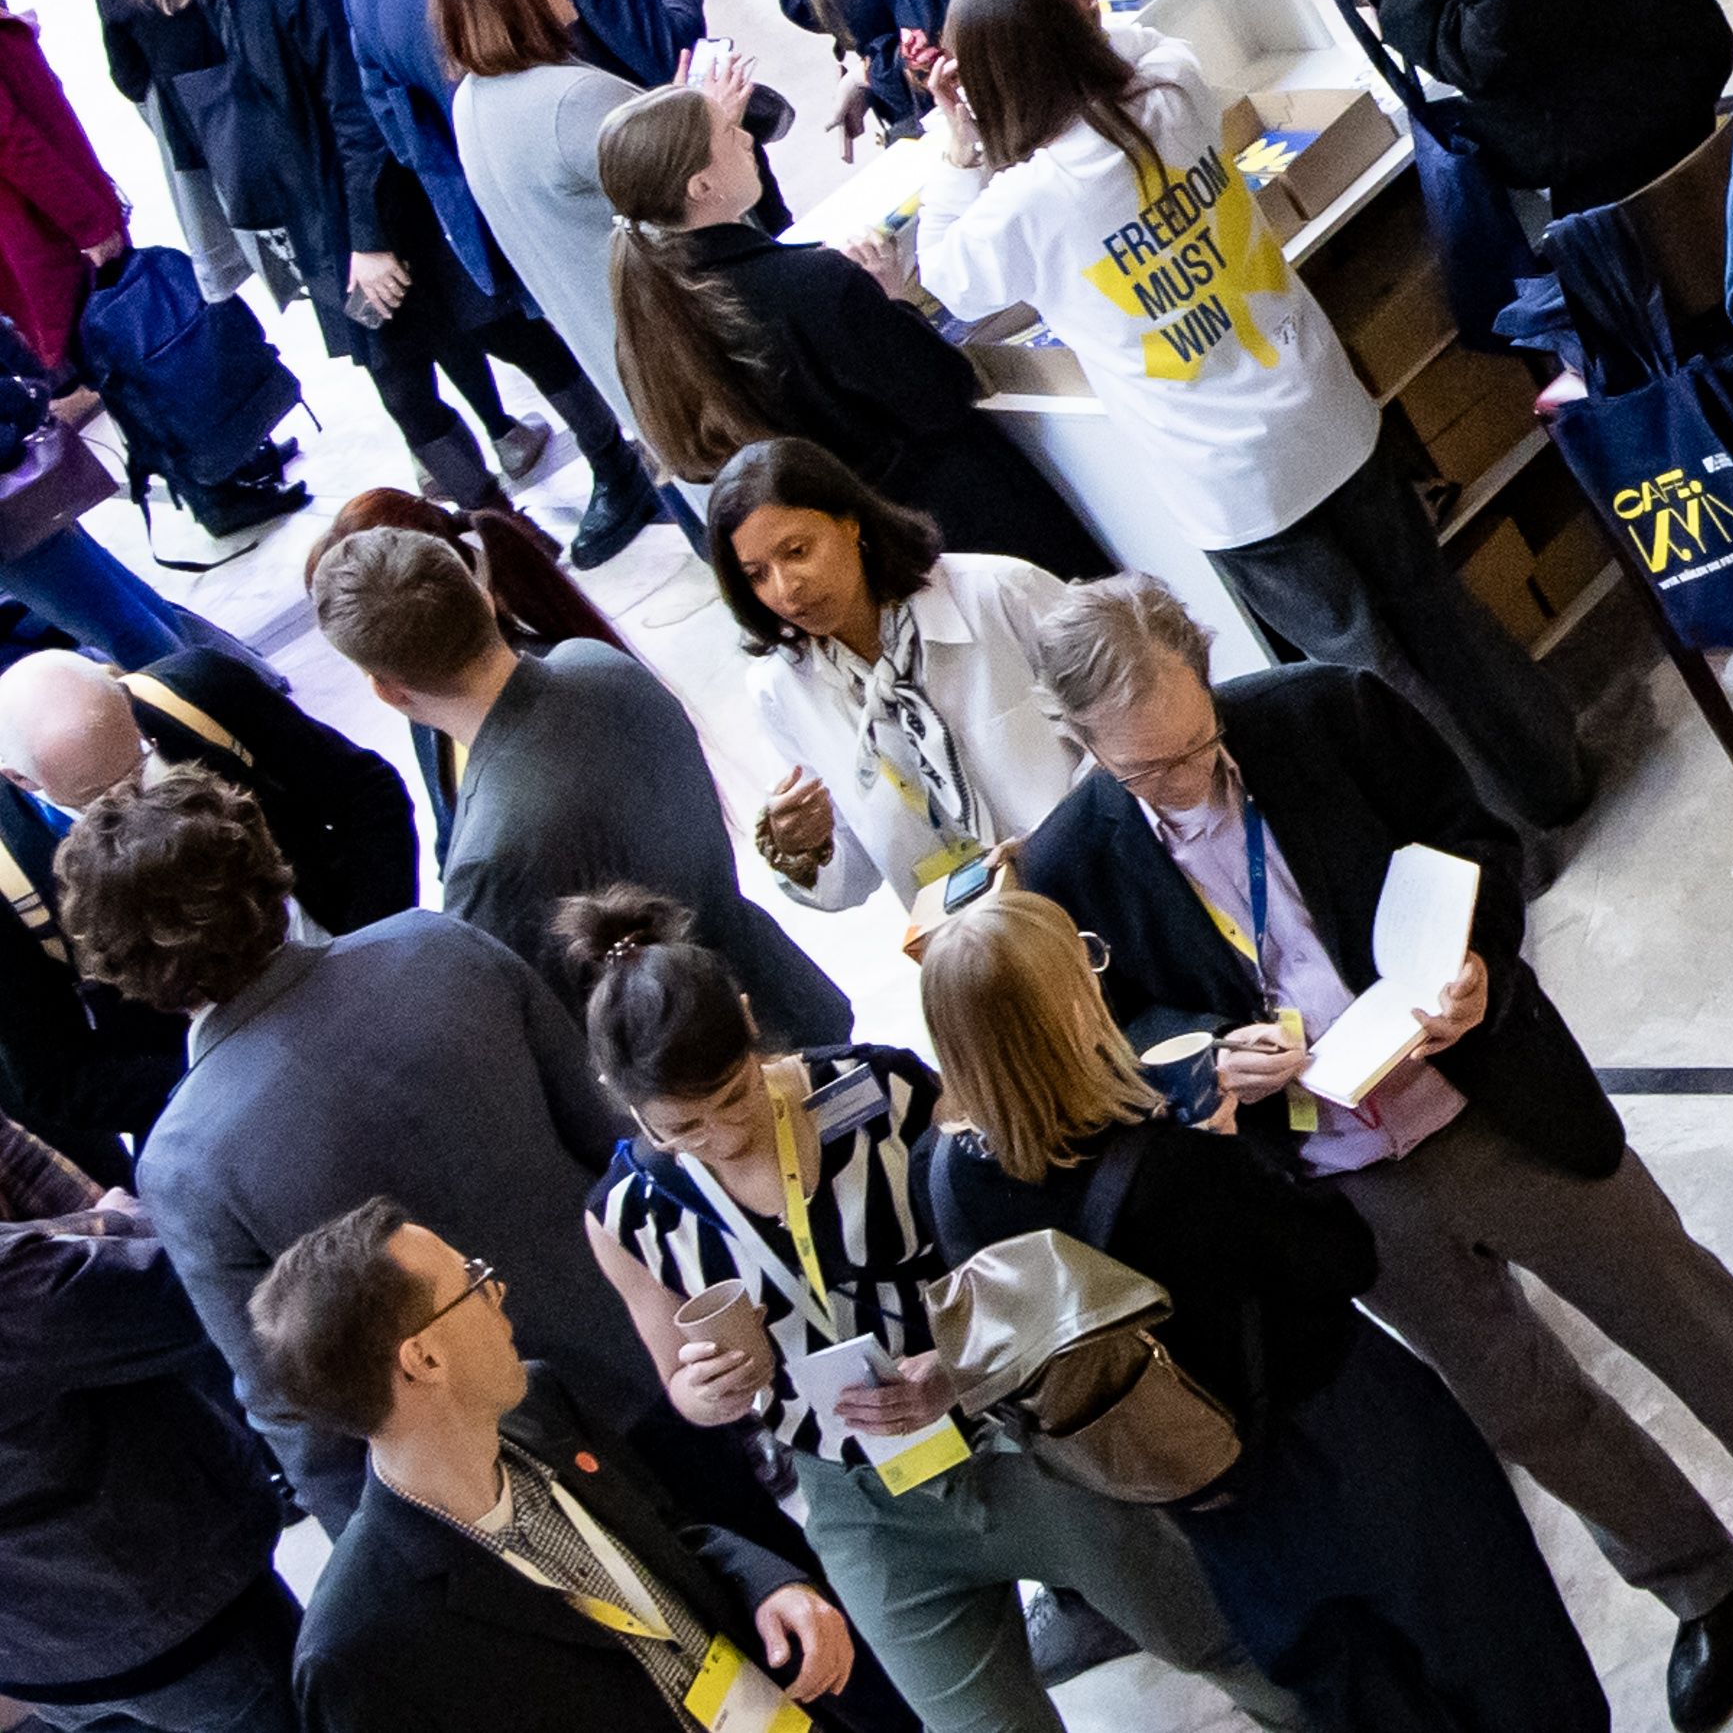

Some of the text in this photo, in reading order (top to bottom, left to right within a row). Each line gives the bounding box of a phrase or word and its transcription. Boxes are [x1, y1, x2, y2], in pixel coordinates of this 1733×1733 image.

[1103, 145, 1231, 276] FREEDOM
[1132, 226, 1227, 322] MUST
[1160, 294, 1233, 364] WIN
[1613, 468, 1691, 520] CAFE
